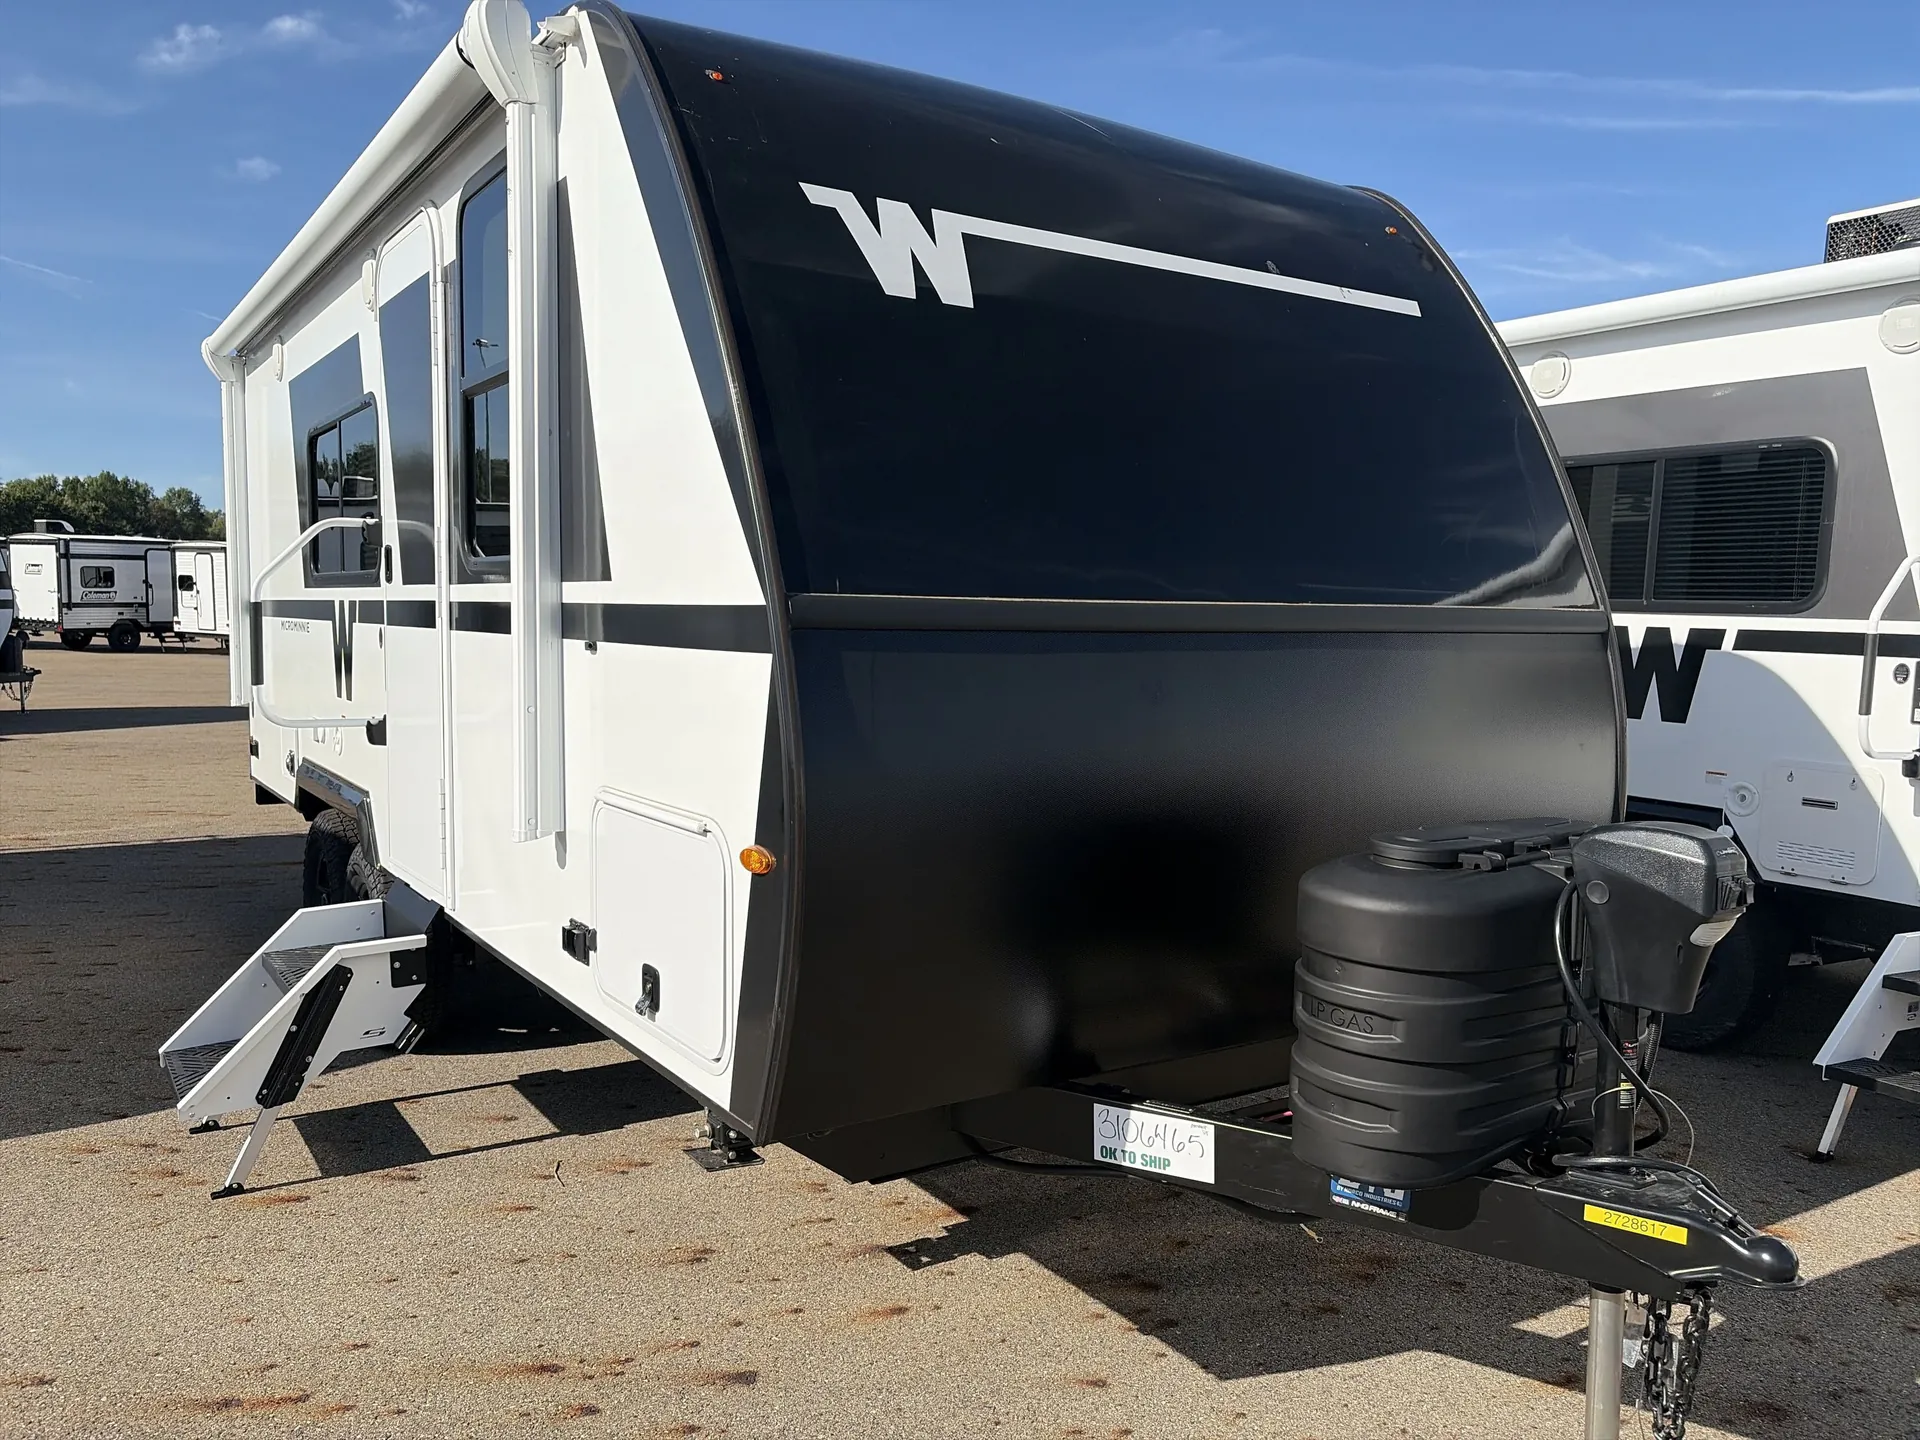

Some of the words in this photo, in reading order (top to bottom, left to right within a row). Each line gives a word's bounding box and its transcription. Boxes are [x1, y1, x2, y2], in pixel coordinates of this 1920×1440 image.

[82, 591, 109, 600] Coleman
[1310, 995, 1326, 1019] LP
[1330, 1007, 1374, 1034] GAS
[1100, 1145, 1118, 1161] OK
[1120, 1149, 1136, 1165] TO
[1140, 1153, 1171, 1171] SHIP
[1363, 1192, 1397, 1206] INDUSTRIES
[1603, 1211, 1668, 1237] 2728617
